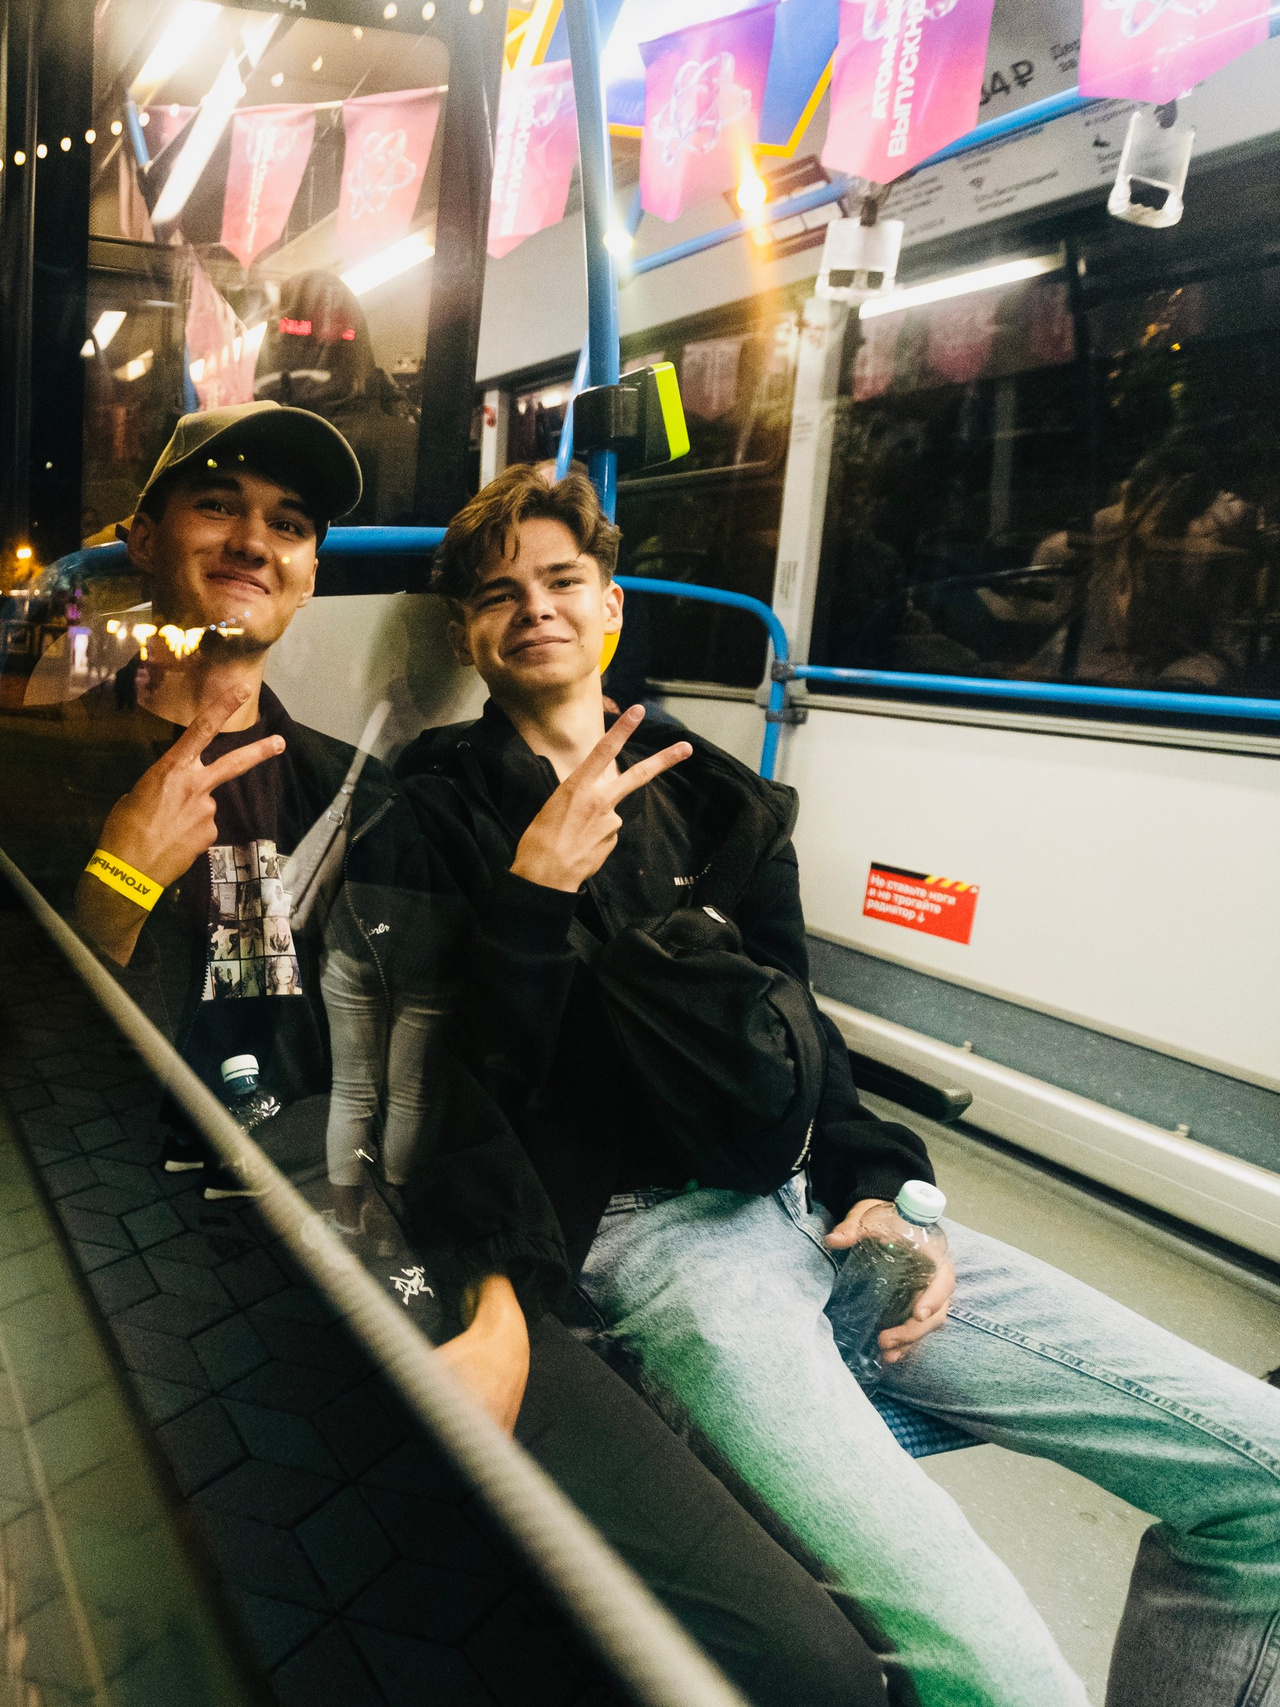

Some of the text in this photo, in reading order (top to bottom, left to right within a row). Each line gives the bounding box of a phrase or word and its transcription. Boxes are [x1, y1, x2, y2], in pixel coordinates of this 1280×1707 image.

[872, 0, 903, 119] АТОМН
[888, 0, 927, 158] ВЫПУСКНО
[868, 887, 942, 914] и не трогайте
[871, 874, 956, 906] Не ставьте ноги
[867, 898, 916, 921] радиатор
